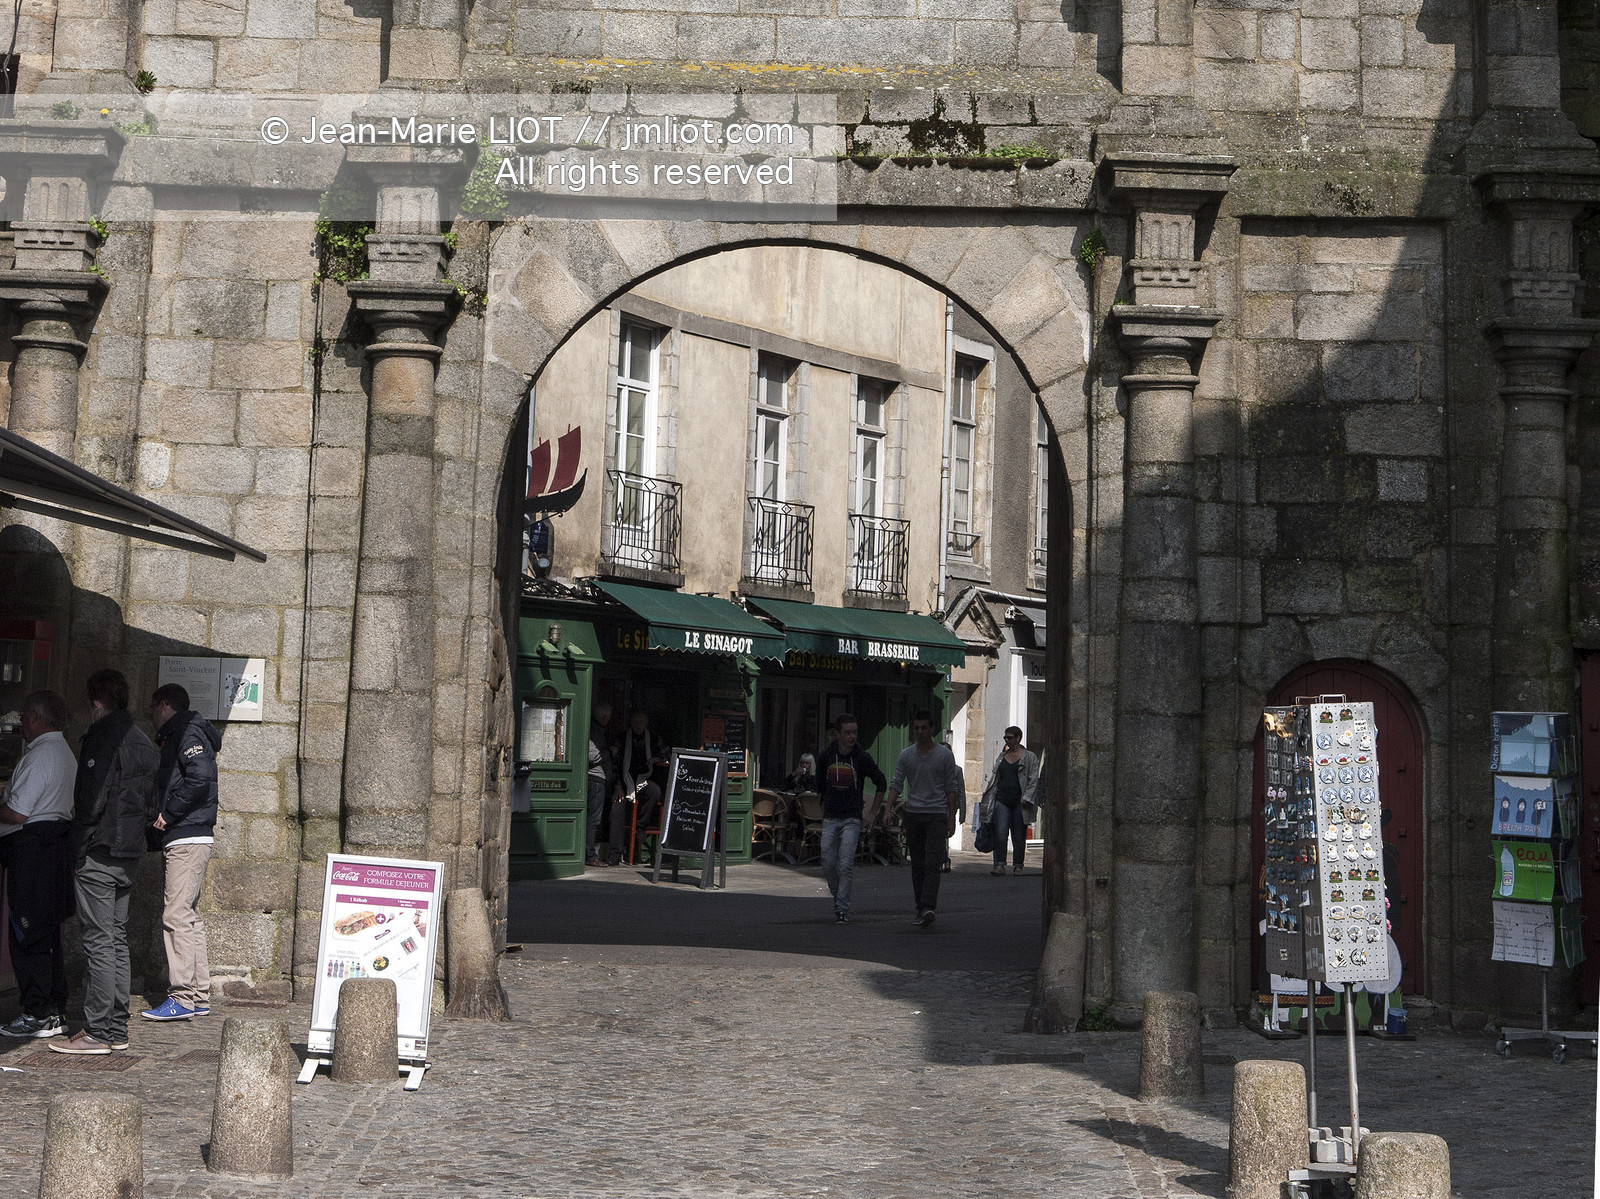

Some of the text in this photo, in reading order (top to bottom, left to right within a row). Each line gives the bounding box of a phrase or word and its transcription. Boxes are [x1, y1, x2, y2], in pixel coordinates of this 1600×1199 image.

[684, 631, 700, 649] LE
[703, 633, 753, 654] SINAGOT
[838, 638, 920, 661] BAR BRASSERIE
[168, 666, 216, 674] Saint-Vincent
[1490, 714, 1500, 769] Dicton breton
[1516, 847, 1552, 862] eau
[363, 877, 395, 886] FORMULE
[366, 869, 426, 881] COMPOSEZ VOTRE
